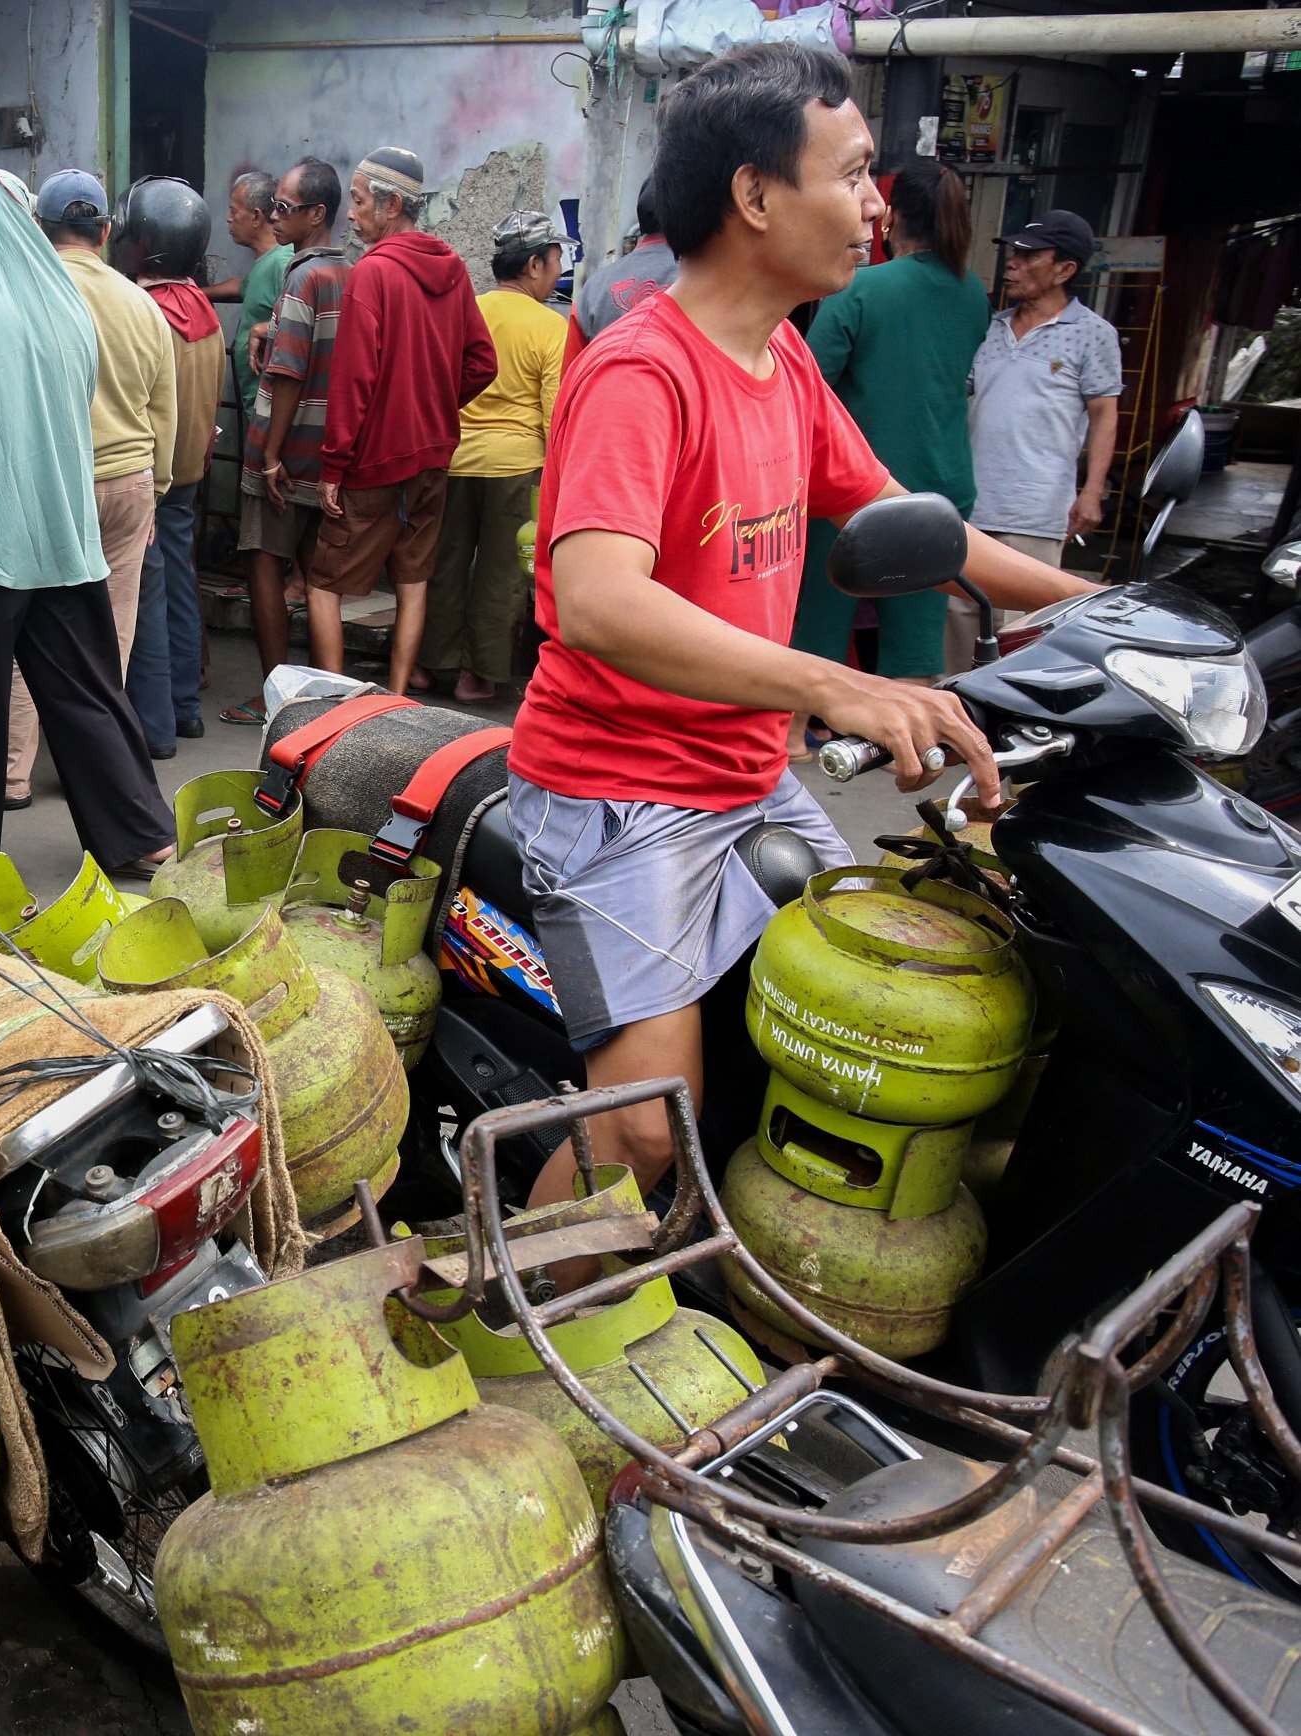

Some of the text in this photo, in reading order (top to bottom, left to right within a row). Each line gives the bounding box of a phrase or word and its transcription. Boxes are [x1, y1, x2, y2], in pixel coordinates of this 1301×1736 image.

[763, 975, 925, 1056] MASYARAKAT MISKIN
[771, 1022, 883, 1087] HANYA UNTUK
[1186, 1141, 1269, 1195] YAMAHA
